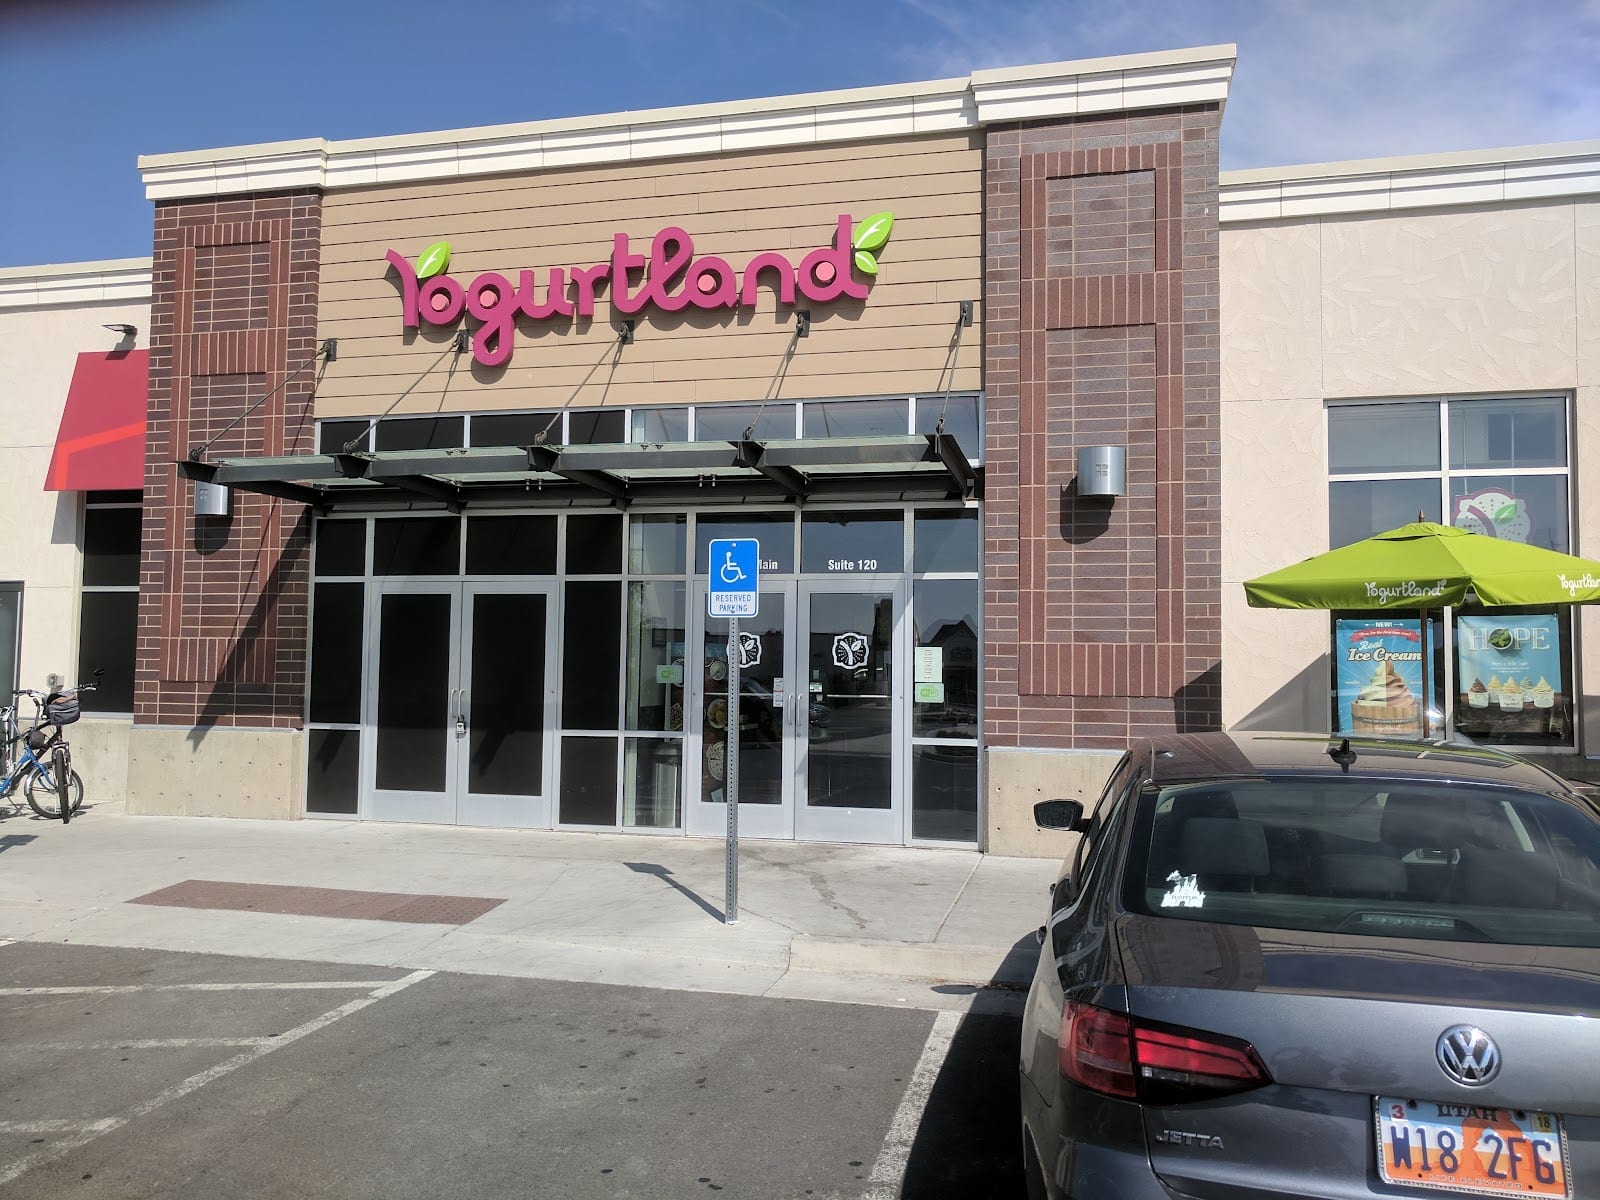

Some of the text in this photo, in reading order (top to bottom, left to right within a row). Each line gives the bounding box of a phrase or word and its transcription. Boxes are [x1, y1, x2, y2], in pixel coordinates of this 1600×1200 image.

[385, 214, 868, 367] Yogurtland
[828, 559, 877, 570] Suite 120
[715, 594, 752, 602] RESERVED
[1365, 580, 1446, 604] Yogurtland
[719, 604, 748, 612] PARKING
[1358, 639, 1383, 651] Real
[1468, 627, 1551, 651] HOPE
[1347, 647, 1422, 661] Ice Cream
[1391, 1104, 1405, 1119] 3
[1436, 1103, 1499, 1122] UTAH
[1537, 1114, 1551, 1129] 18
[1155, 1129, 1225, 1149] JETTA
[1390, 1125, 1459, 1174] W18
[1429, 1174, 1523, 1189] LIFE ELEVATED
